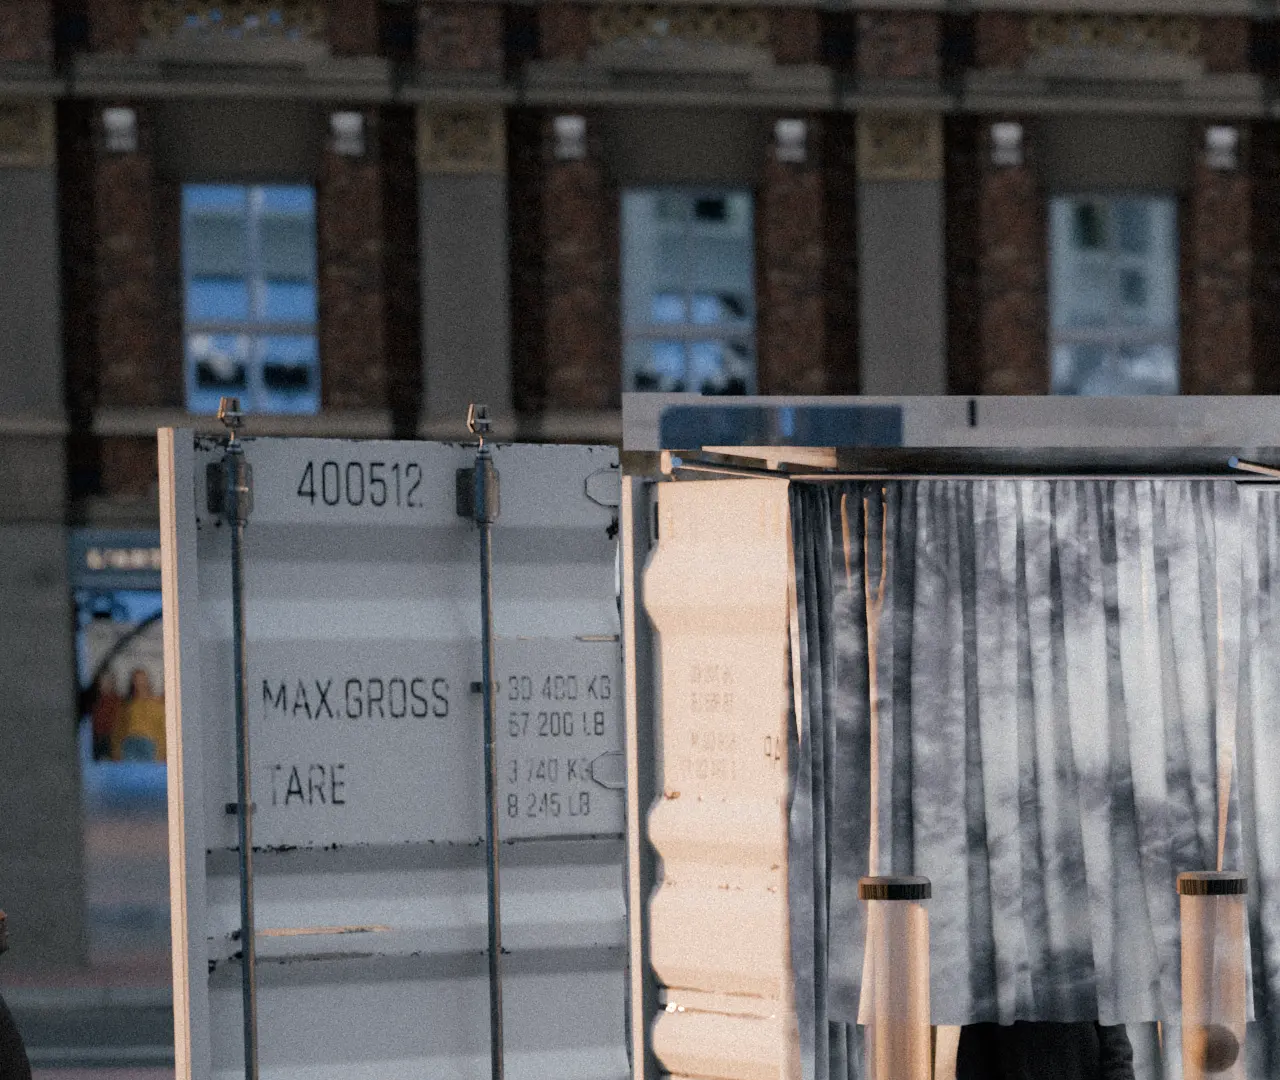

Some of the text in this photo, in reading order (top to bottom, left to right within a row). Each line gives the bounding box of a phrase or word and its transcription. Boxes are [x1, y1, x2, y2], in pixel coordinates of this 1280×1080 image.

[297, 461, 423, 507] 400512
[262, 677, 450, 720] MAX.GROSS
[587, 675, 611, 700] KG
[537, 711, 574, 737] 200
[582, 711, 605, 737] LB
[264, 764, 345, 806] TARE
[507, 793, 519, 819] 8
[568, 791, 591, 816] LB
